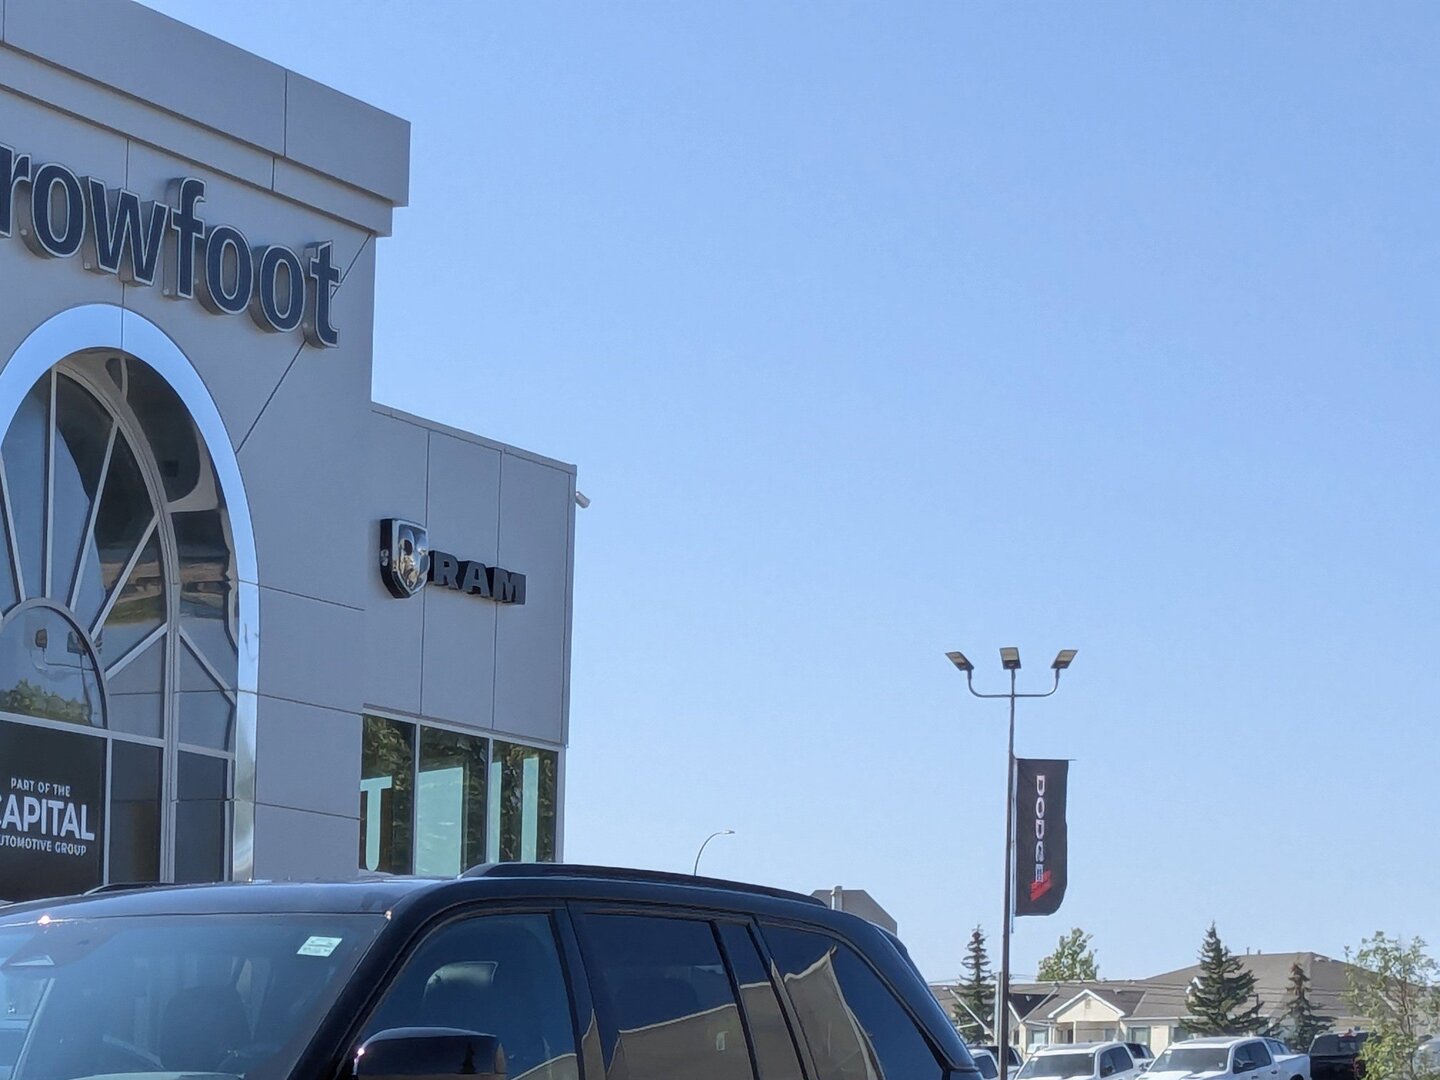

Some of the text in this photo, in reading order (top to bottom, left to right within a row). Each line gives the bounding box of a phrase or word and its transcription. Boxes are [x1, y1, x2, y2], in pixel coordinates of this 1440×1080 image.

[431, 550, 527, 605] RAM
[11, 777, 71, 797] PART OF THE
[1035, 775, 1046, 883] DODGE
[55, 842, 87, 856] GROUP
